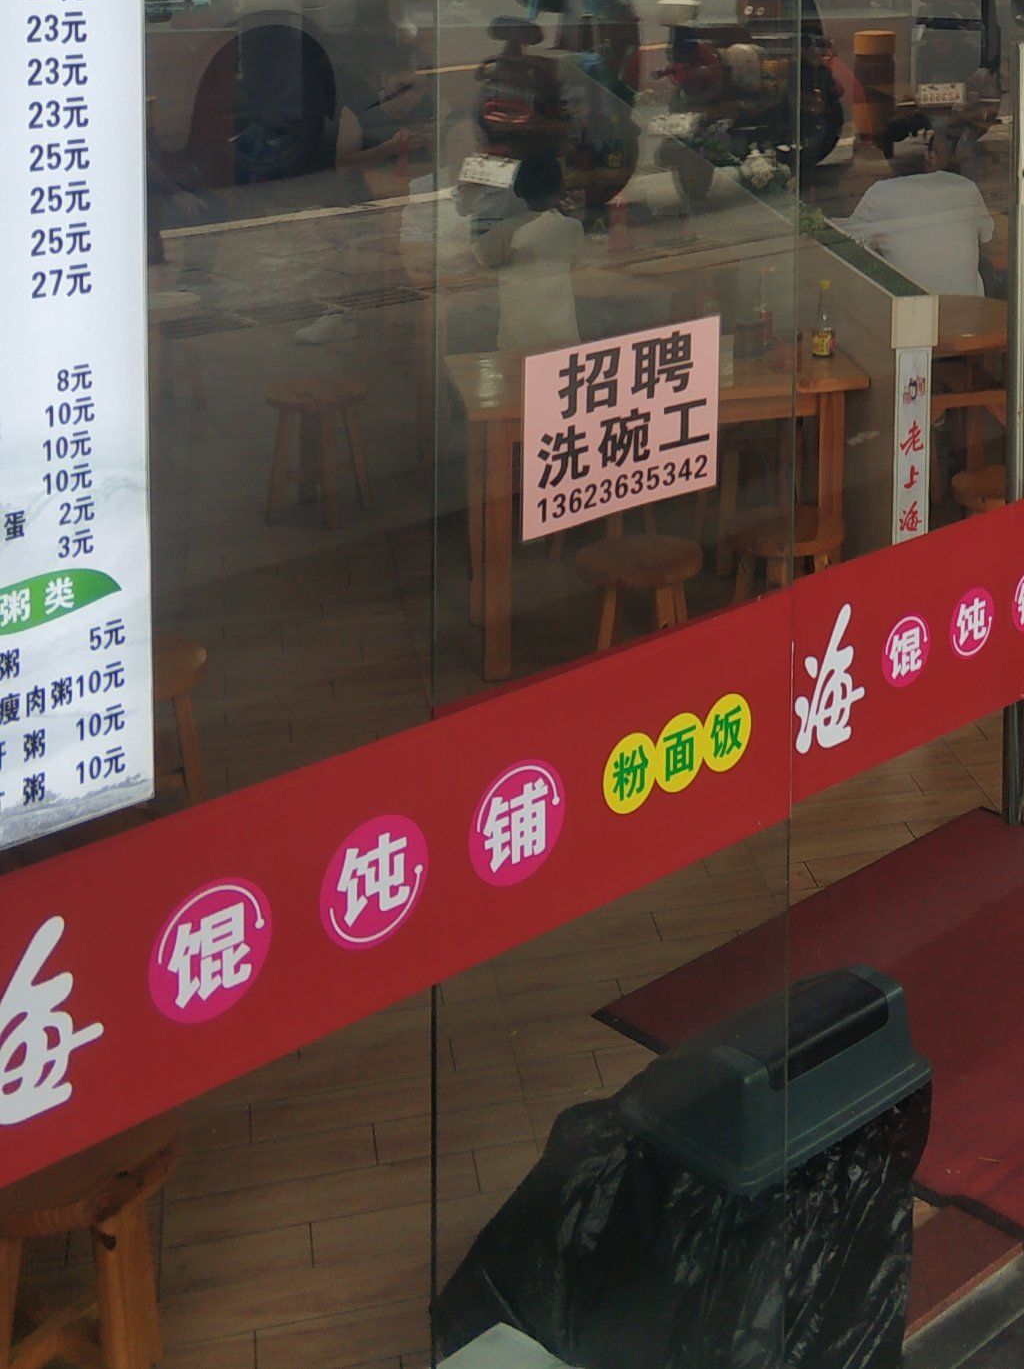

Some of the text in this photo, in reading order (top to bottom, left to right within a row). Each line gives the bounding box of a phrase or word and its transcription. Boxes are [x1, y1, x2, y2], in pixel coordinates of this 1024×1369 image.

[26, 11, 88, 44] 23元
[27, 53, 89, 87] 23元
[28, 96, 90, 130] 23元
[29, 138, 91, 173] 25元
[30, 180, 91, 215] 25元
[30, 221, 92, 257] 25元
[31, 263, 93, 300] 27元
[56, 363, 94, 393] 8元
[558, 331, 694, 420] 招聘
[44, 396, 96, 428] 10元
[42, 430, 93, 462] 10元
[537, 399, 711, 490] 洗碗工
[42, 462, 93, 495] 10元
[537, 454, 709, 524] 13623635342
[899, 420, 925, 533] 老上海
[3, 494, 95, 541] 蛋 2元
[58, 528, 94, 559] 3元
[0, 576, 75, 628] 粥类
[0, 617, 126, 678] 粥 5元
[0, 661, 126, 723] 瘦肉粥 10元
[795, 603, 866, 755] 海
[23, 704, 126, 762] 粥 10元
[612, 702, 745, 804] 粉面饭
[23, 746, 126, 807] 粥 10元
[167, 777, 549, 1011] 馄饨铺
